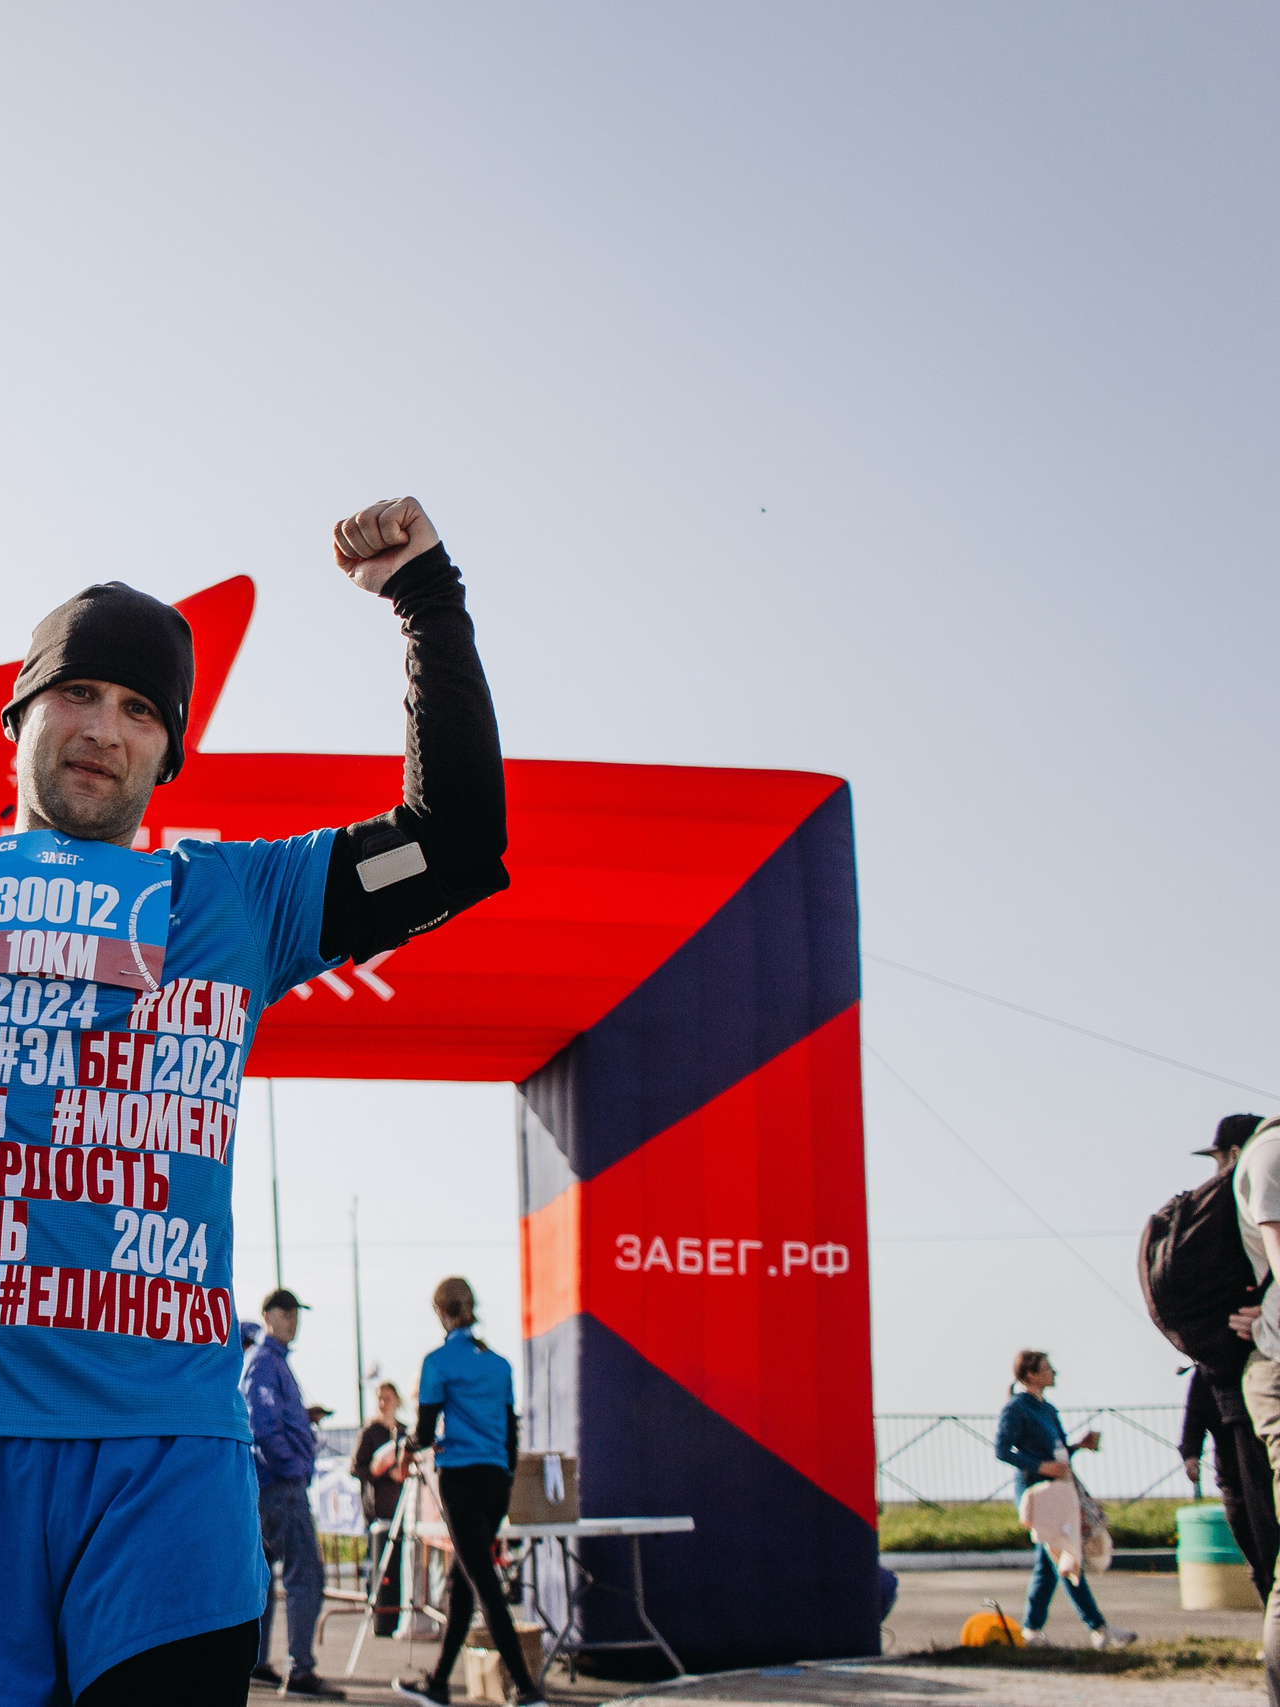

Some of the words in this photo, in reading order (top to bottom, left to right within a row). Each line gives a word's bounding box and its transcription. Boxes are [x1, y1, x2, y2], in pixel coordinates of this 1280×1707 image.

[131, 978, 250, 1045] #ЦЕЛЬ
[52, 1089, 237, 1165] #МОМЕНТ
[111, 1210, 208, 1283] 2024
[614, 1233, 850, 1278] ЗАБЕГ.РФ
